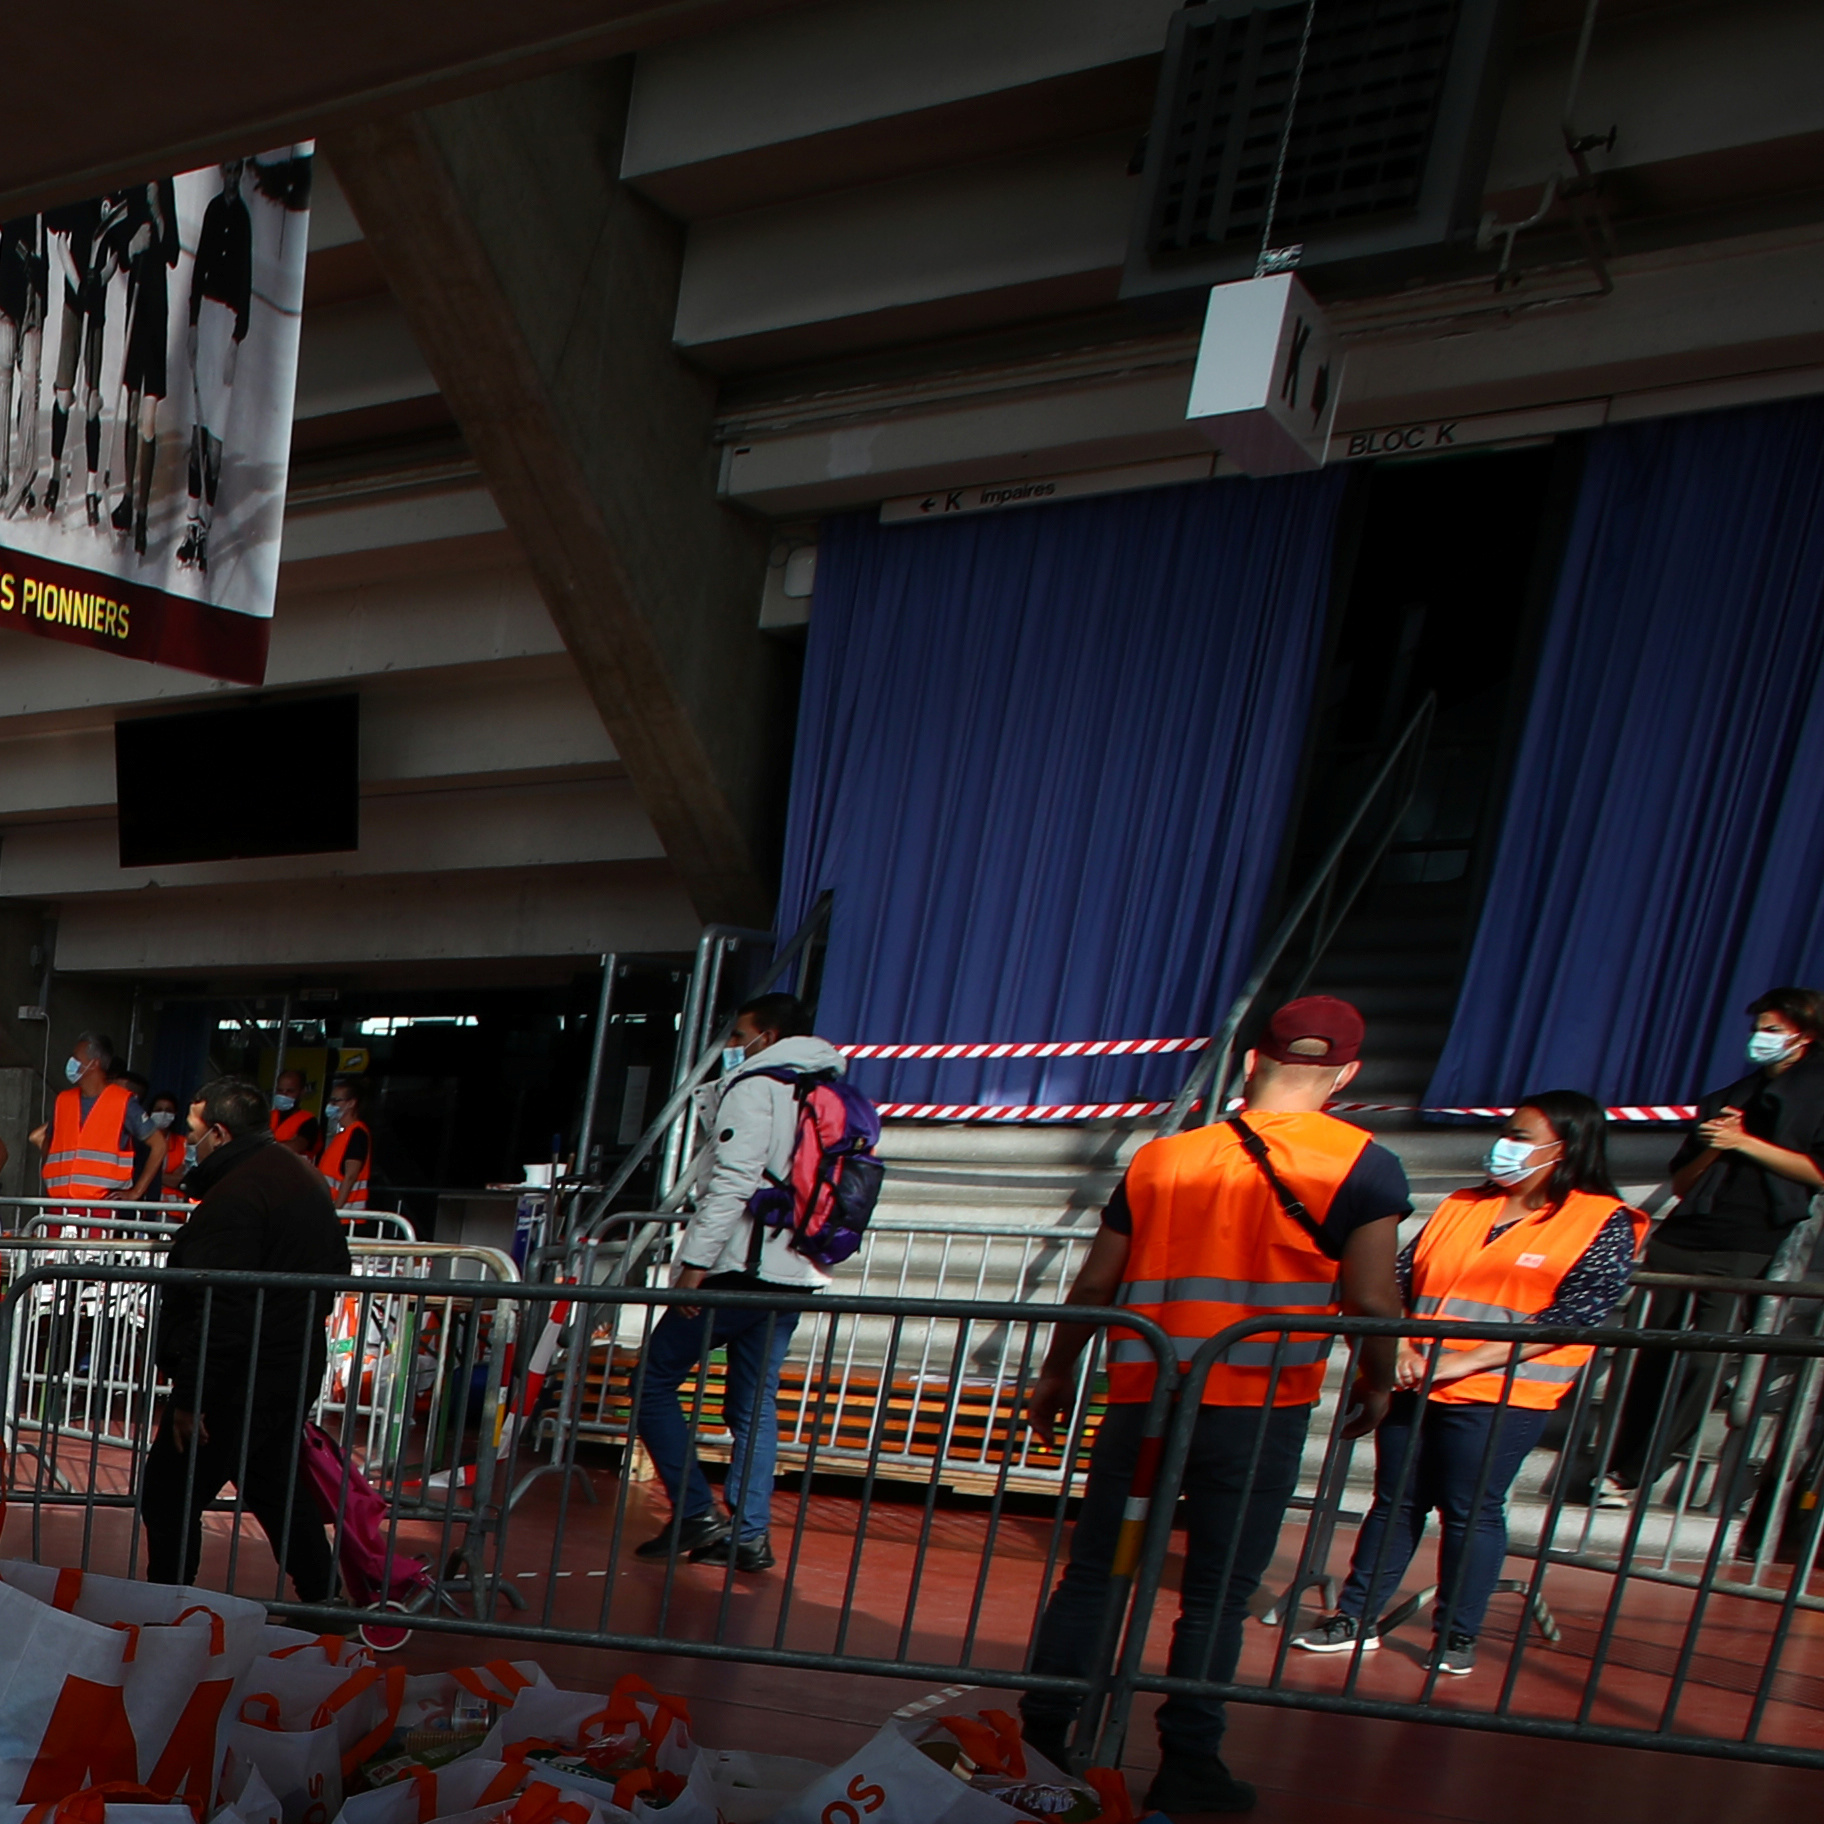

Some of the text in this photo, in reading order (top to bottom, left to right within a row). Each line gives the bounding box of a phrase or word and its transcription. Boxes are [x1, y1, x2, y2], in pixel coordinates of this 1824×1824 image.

[1347, 421, 1458, 458] BLOC K
[944, 480, 1056, 511] K impaires
[22, 577, 130, 639] PIONNIERS
